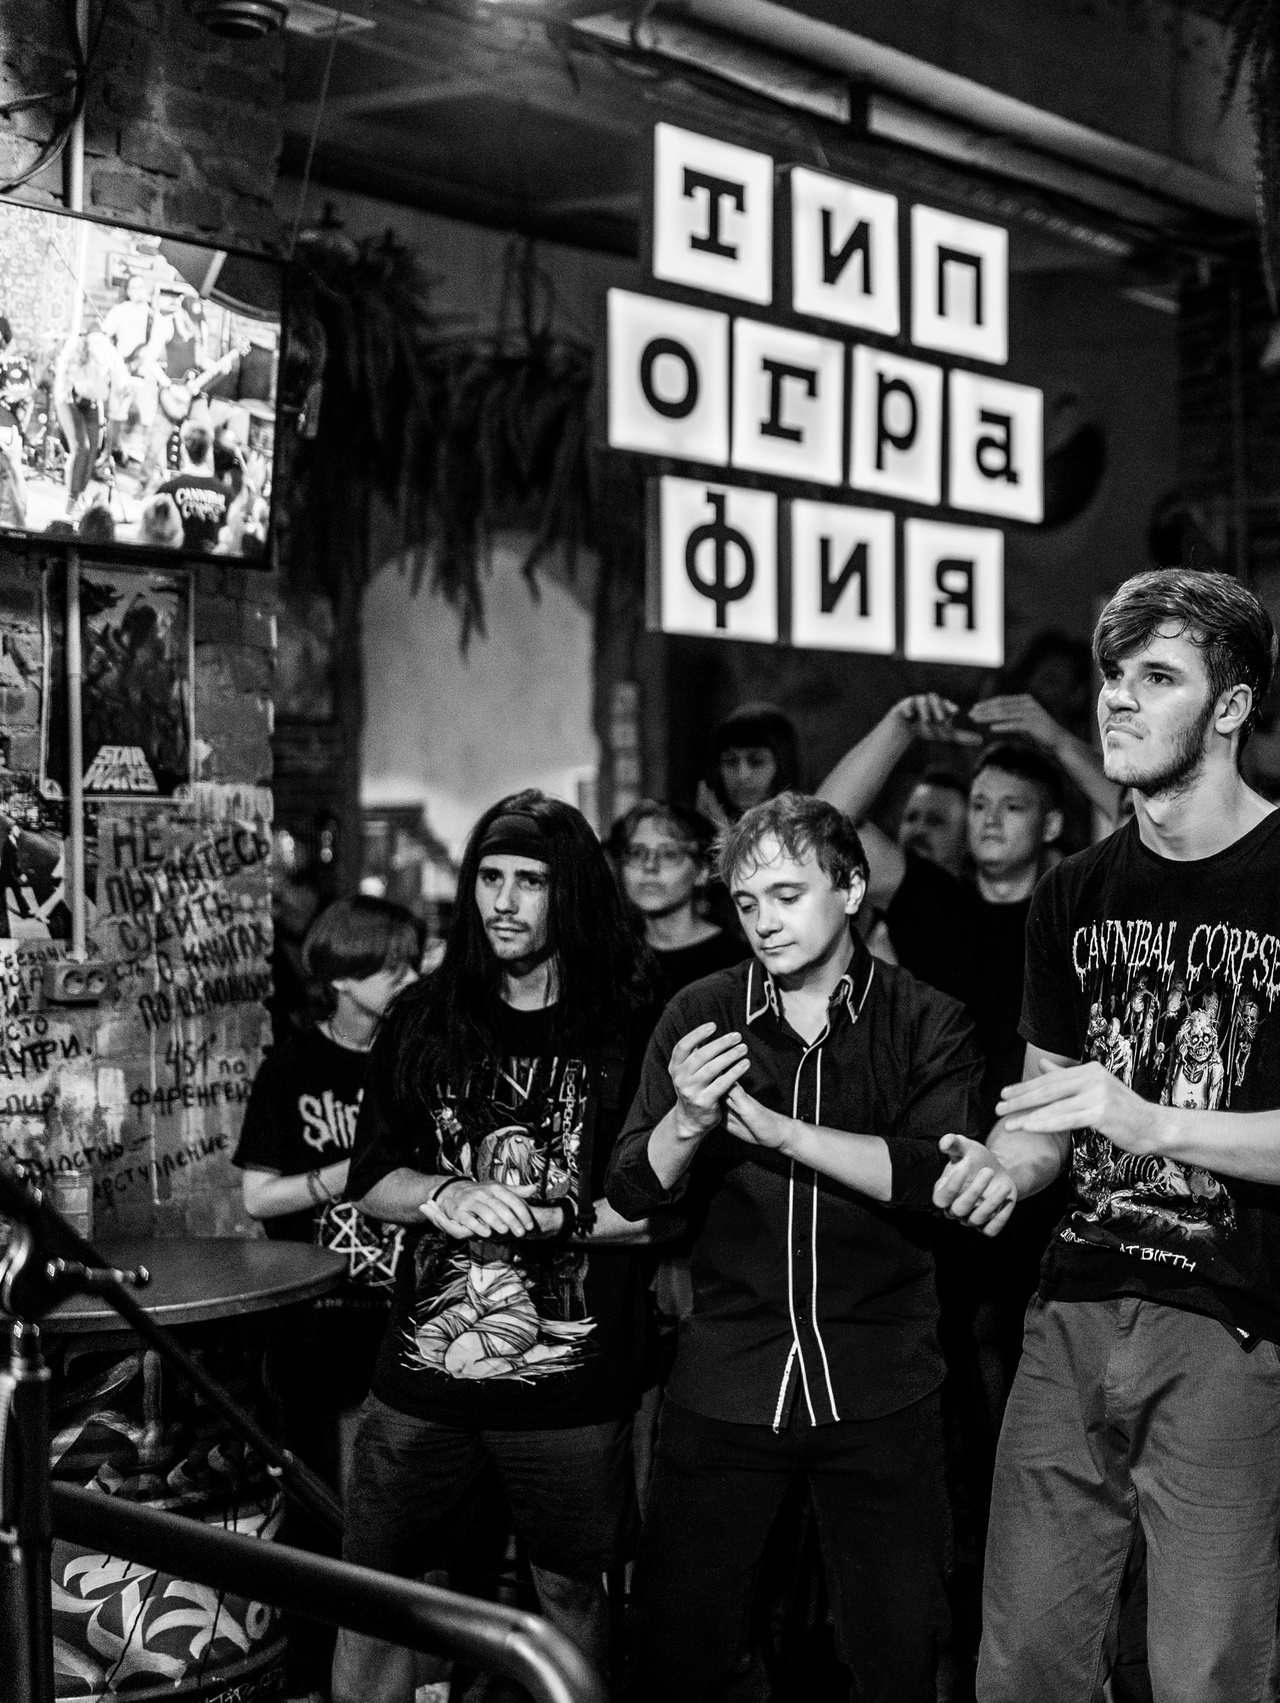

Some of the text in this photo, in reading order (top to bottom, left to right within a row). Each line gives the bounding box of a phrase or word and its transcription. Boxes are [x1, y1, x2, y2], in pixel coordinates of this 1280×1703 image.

[94, 744, 149, 766] STAR
[111, 815, 165, 868] НЕ
[1072, 919, 1177, 986] CANNIBAL
[1141, 1247, 1197, 1272] BIRTH
